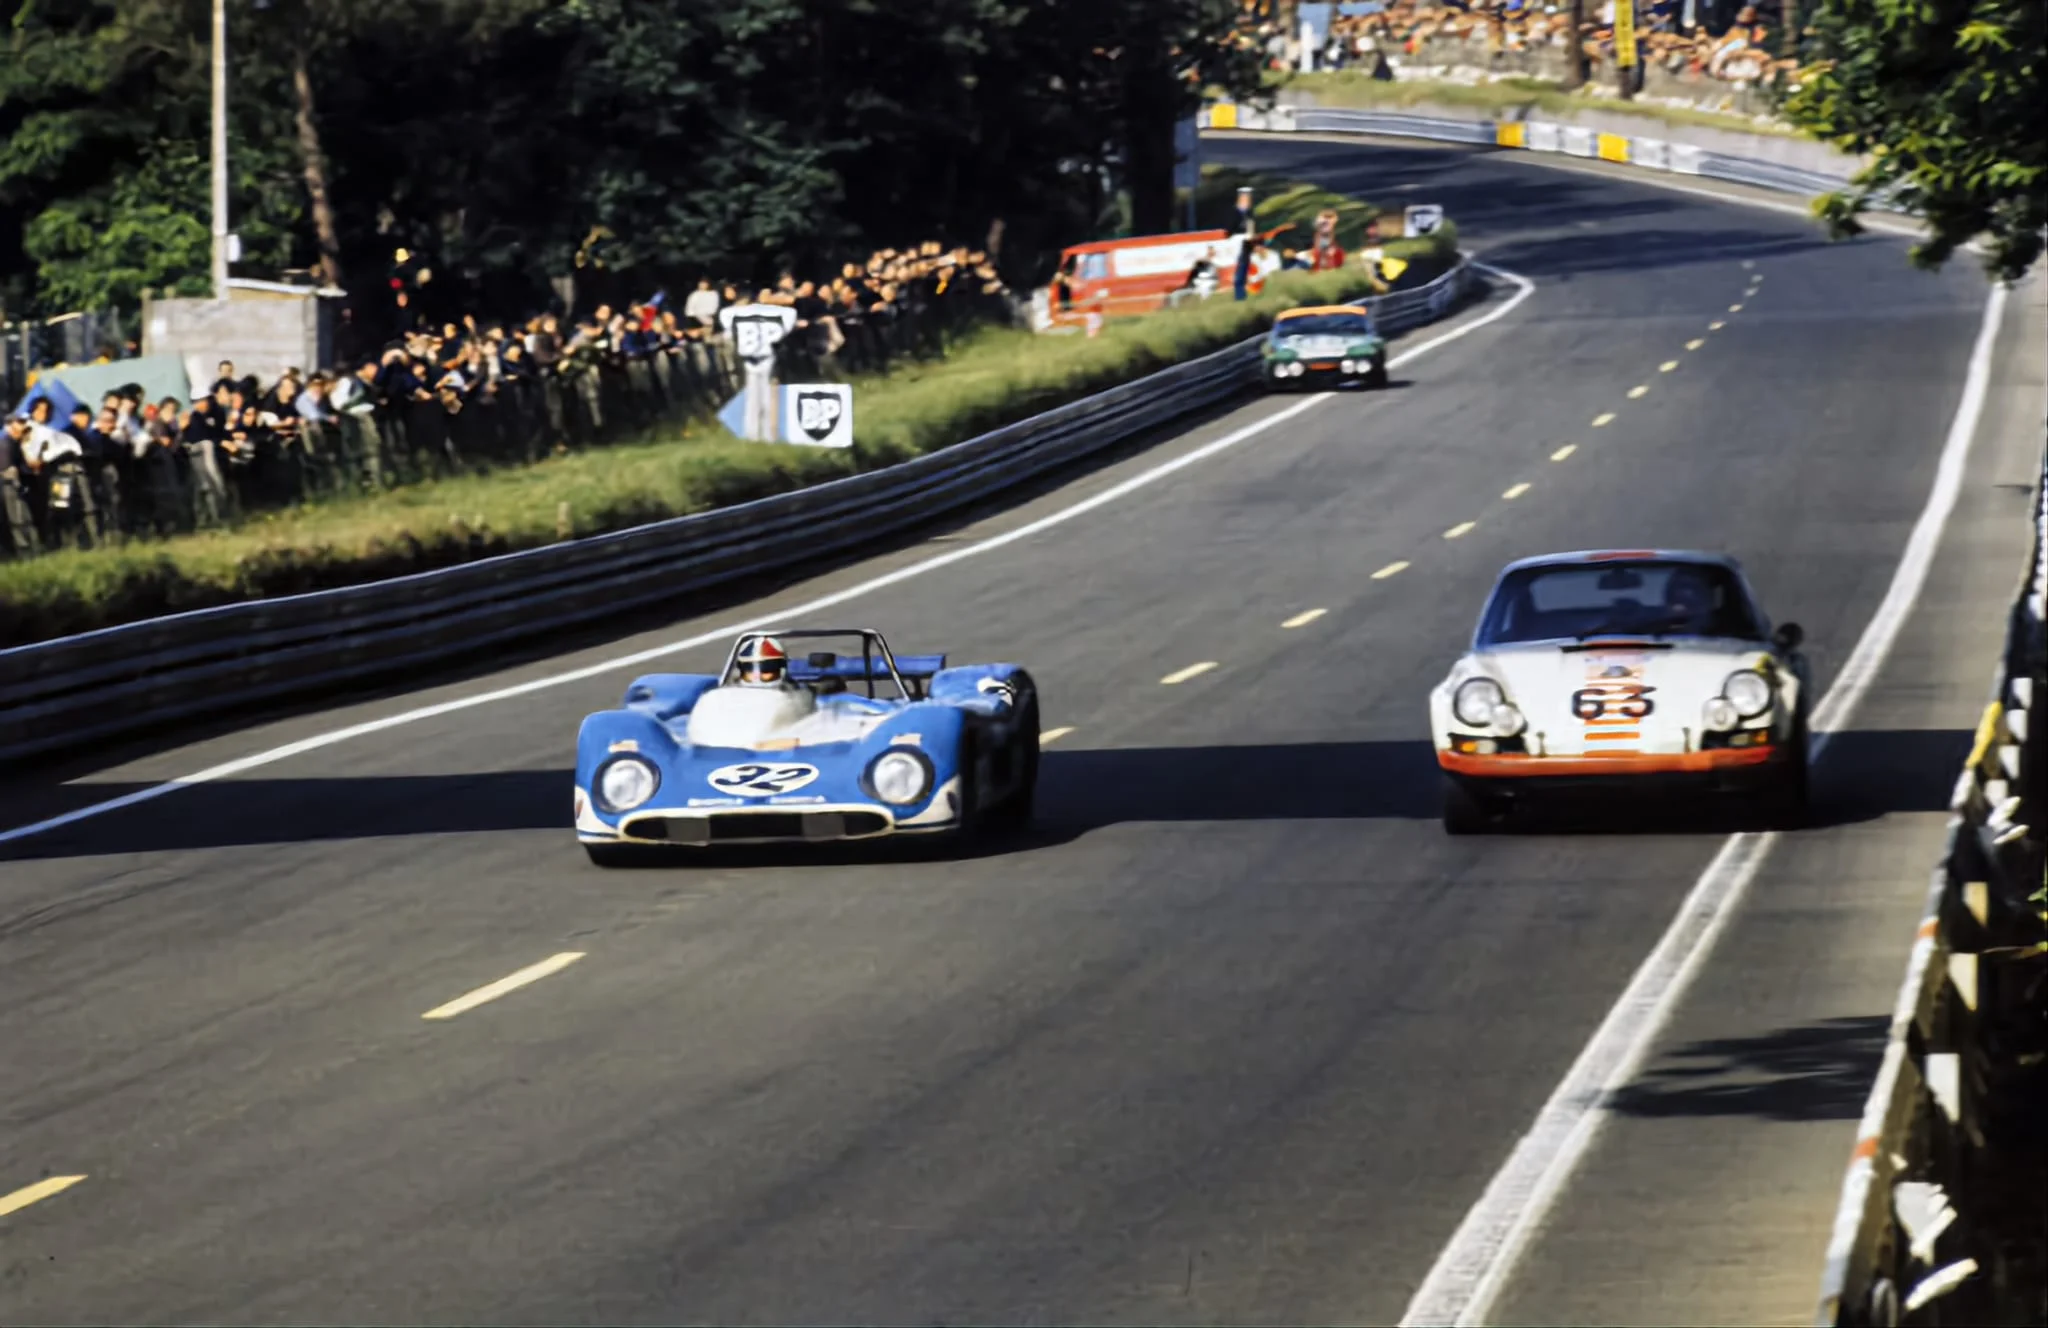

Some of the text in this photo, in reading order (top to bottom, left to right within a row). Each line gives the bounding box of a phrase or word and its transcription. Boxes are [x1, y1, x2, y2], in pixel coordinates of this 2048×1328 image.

[736, 322, 784, 356] BP
[800, 398, 840, 430] BP
[1572, 686, 1657, 720] 63
[715, 765, 812, 792] 32
